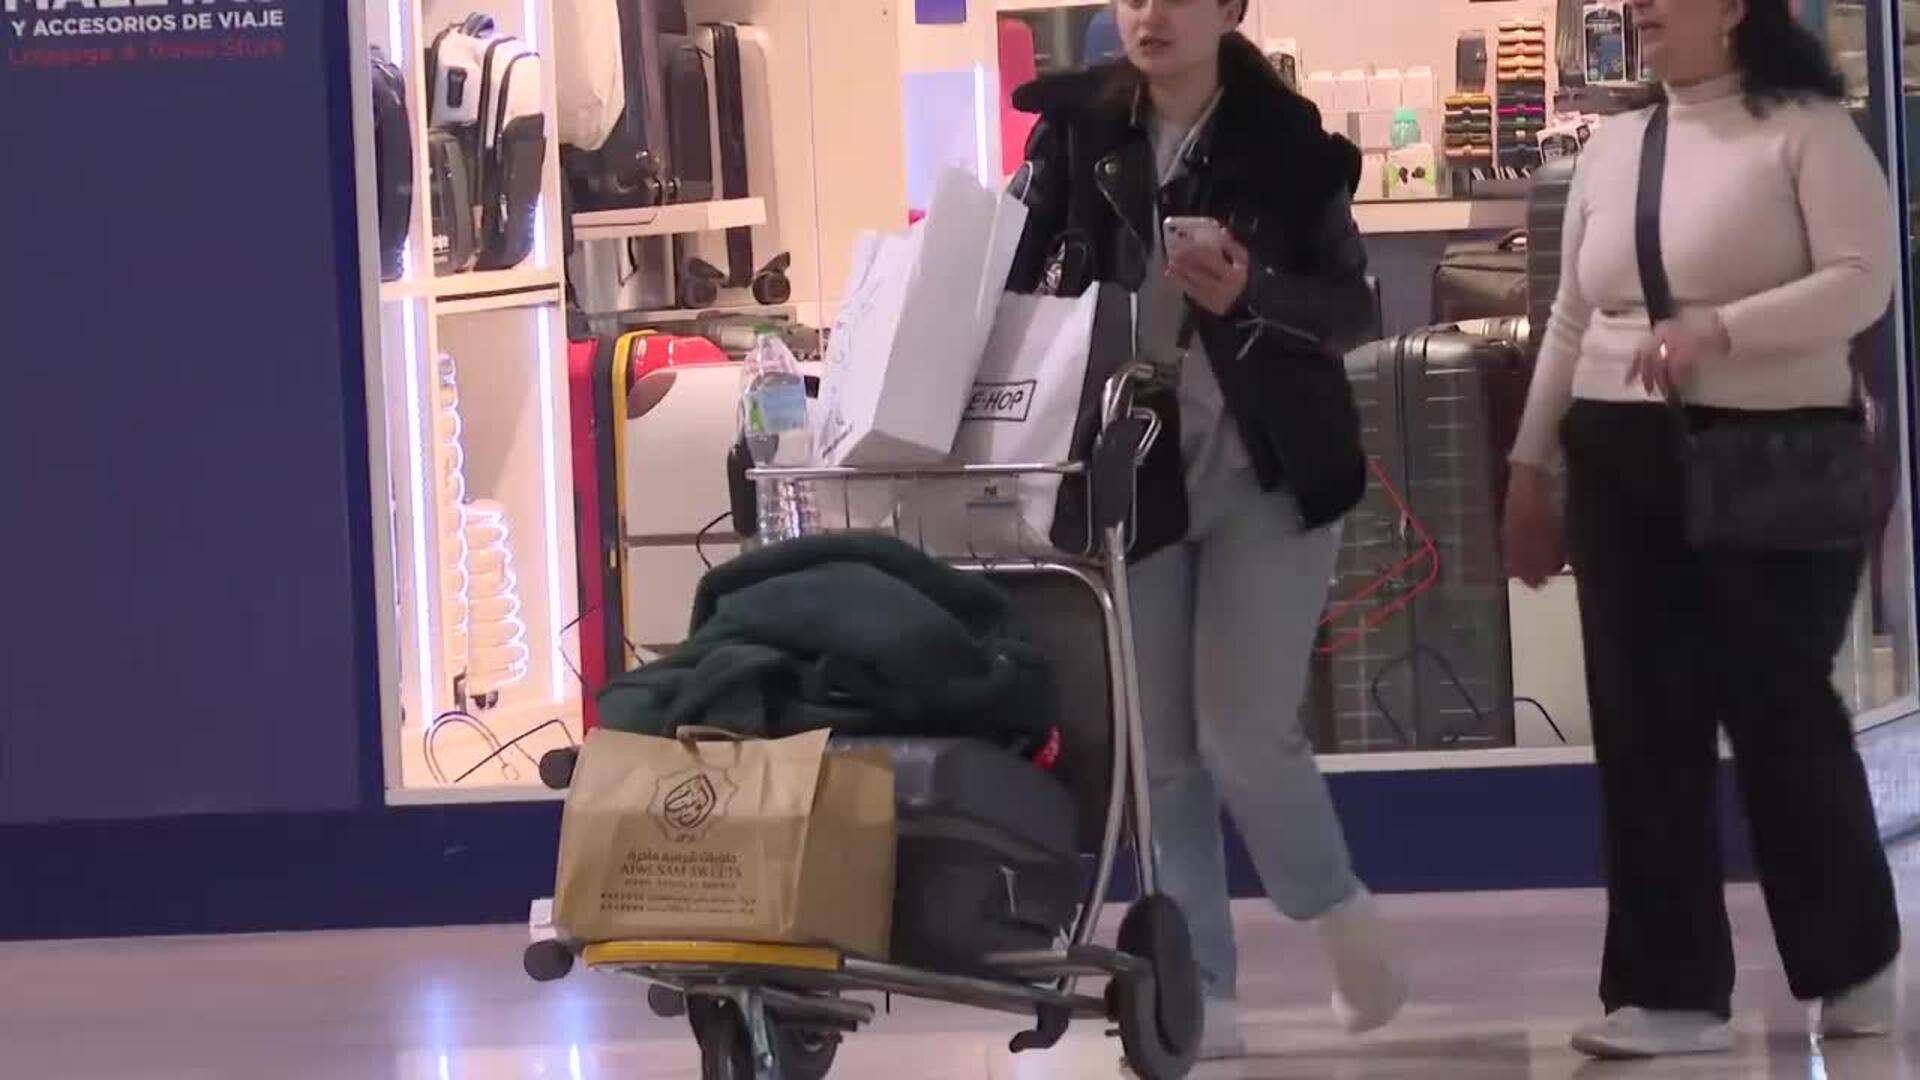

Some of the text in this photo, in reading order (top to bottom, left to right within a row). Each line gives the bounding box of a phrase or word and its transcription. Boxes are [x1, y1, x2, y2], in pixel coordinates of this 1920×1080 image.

[11, 9, 284, 37] Y ACCESORIOS DE VIAJE
